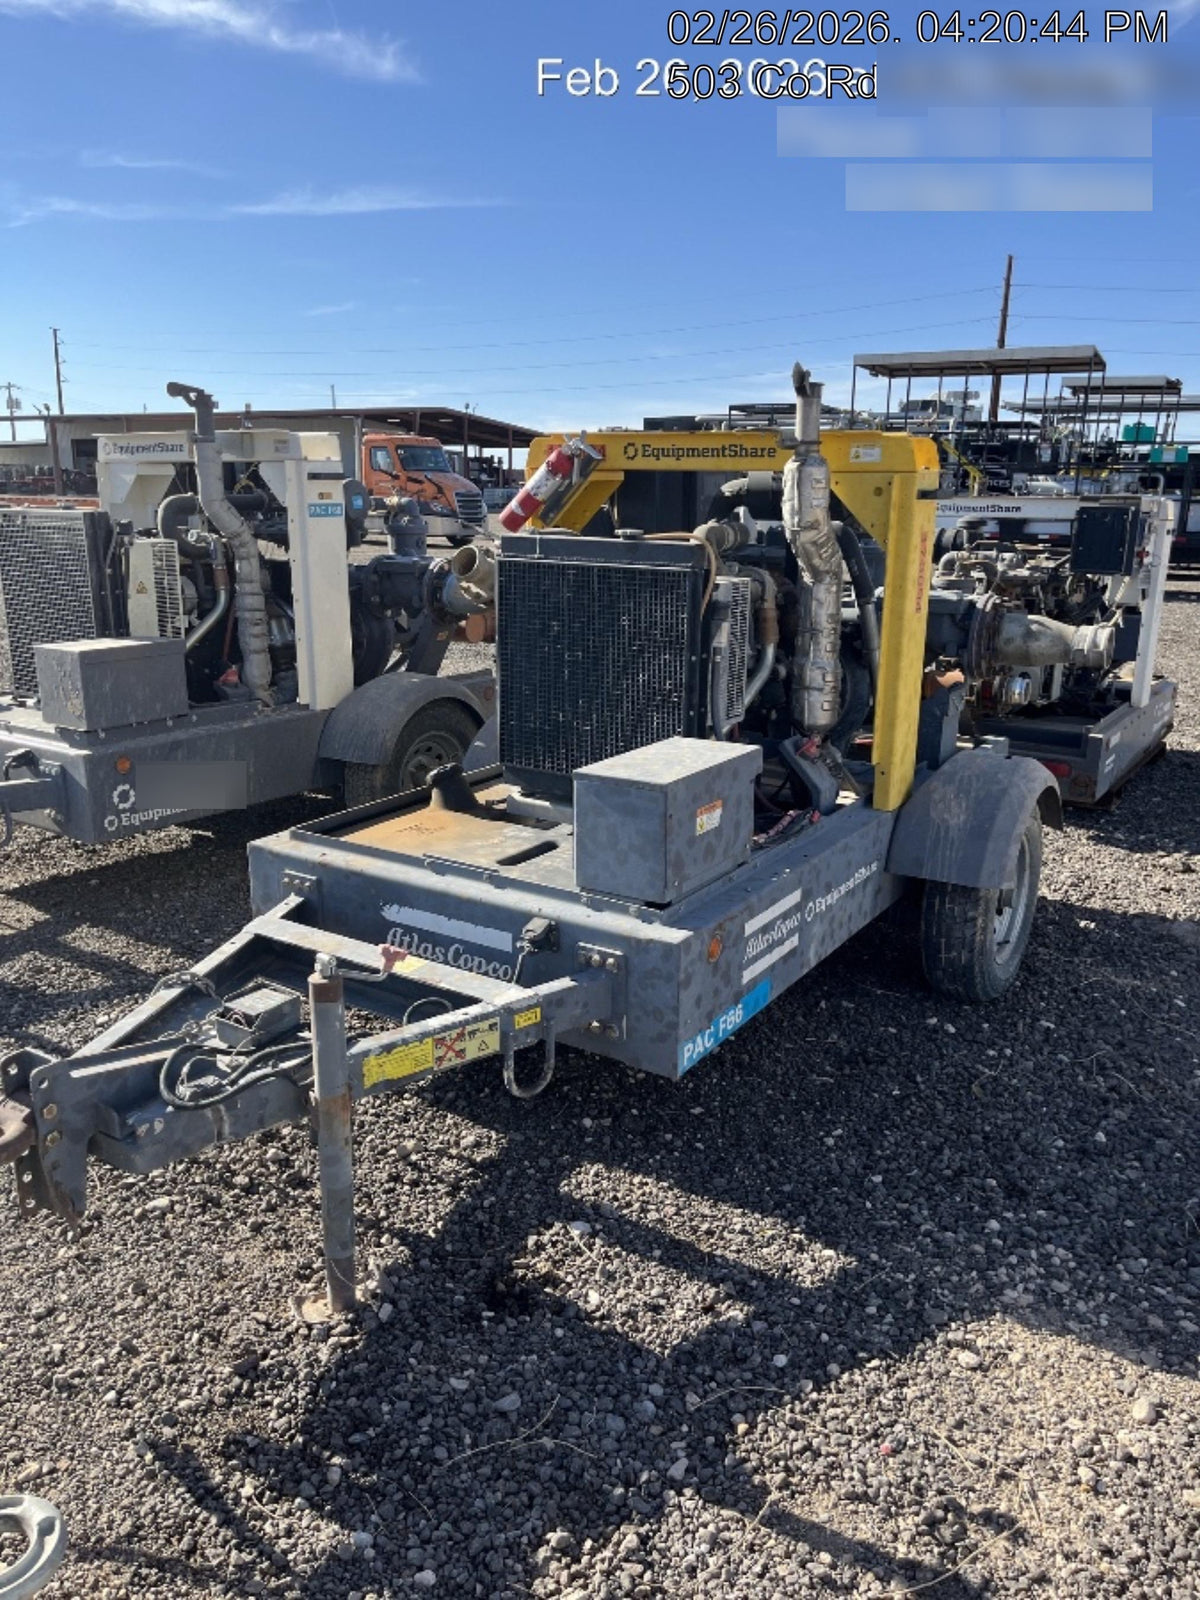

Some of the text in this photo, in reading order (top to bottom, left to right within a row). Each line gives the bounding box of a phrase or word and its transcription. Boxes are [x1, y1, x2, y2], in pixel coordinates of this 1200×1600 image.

[641, 444, 777, 461] EquipmentShare
[815, 860, 878, 913] EquipmentShare
[386, 927, 512, 980] Atlas Copco
[682, 1003, 743, 1066] PAC F66
